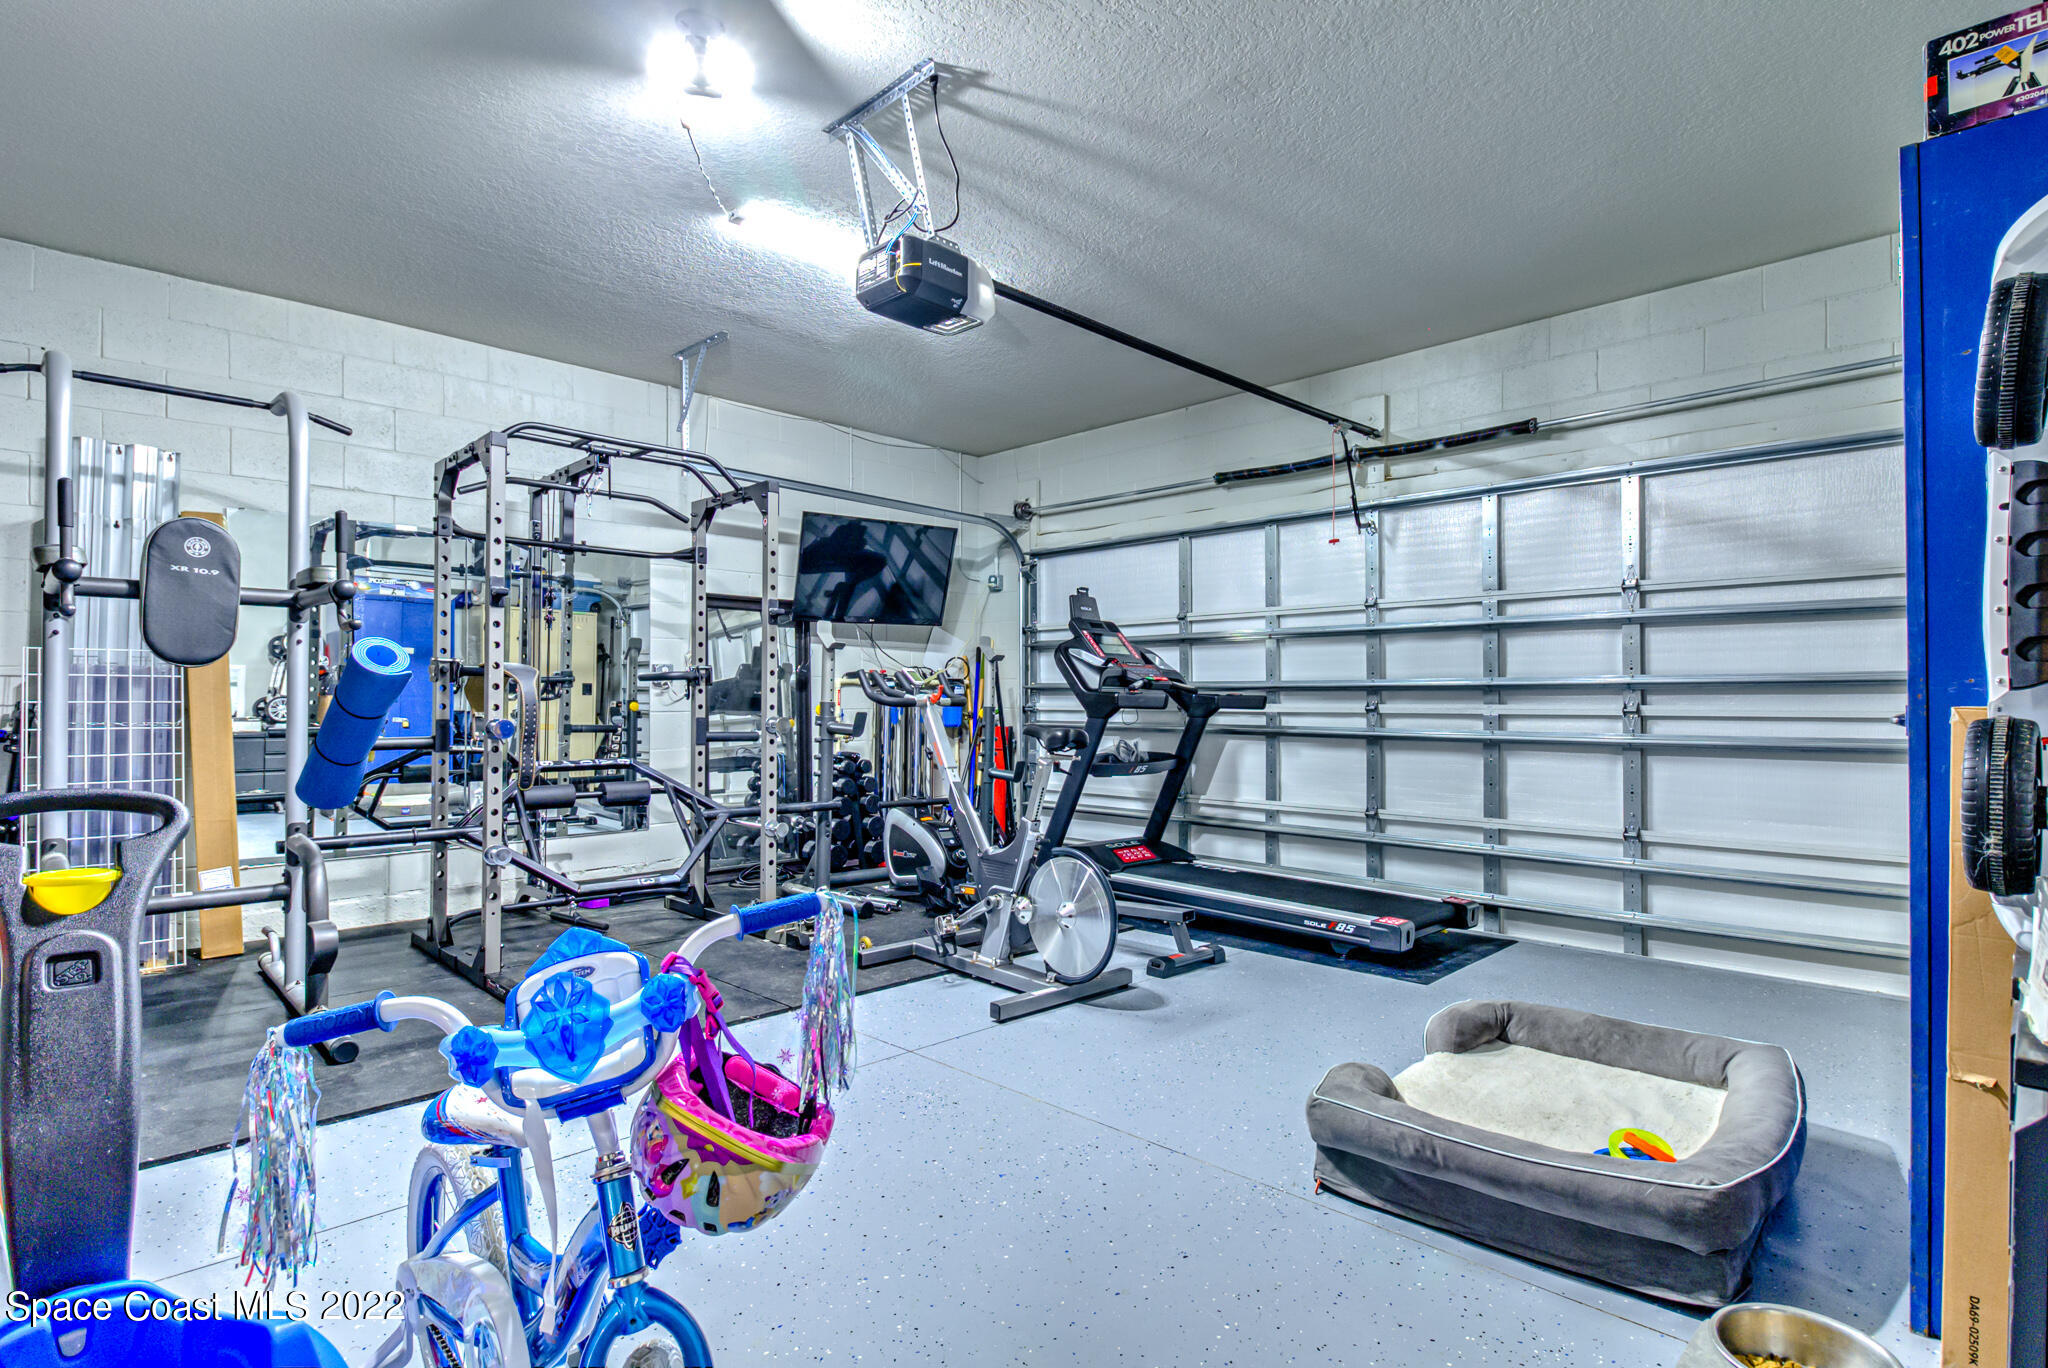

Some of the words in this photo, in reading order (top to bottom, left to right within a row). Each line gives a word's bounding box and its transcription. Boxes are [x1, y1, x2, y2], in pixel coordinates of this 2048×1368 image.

[1938, 32, 1979, 56] 402
[1979, 24, 2016, 41] POWER
[2014, 8, 2048, 32] TEL
[170, 564, 190, 573] XR
[193, 567, 220, 575] 10.9
[1303, 919, 1327, 929] SOLE
[1327, 921, 1357, 934] F85
[1968, 1295, 1980, 1367] DA69-02509K
